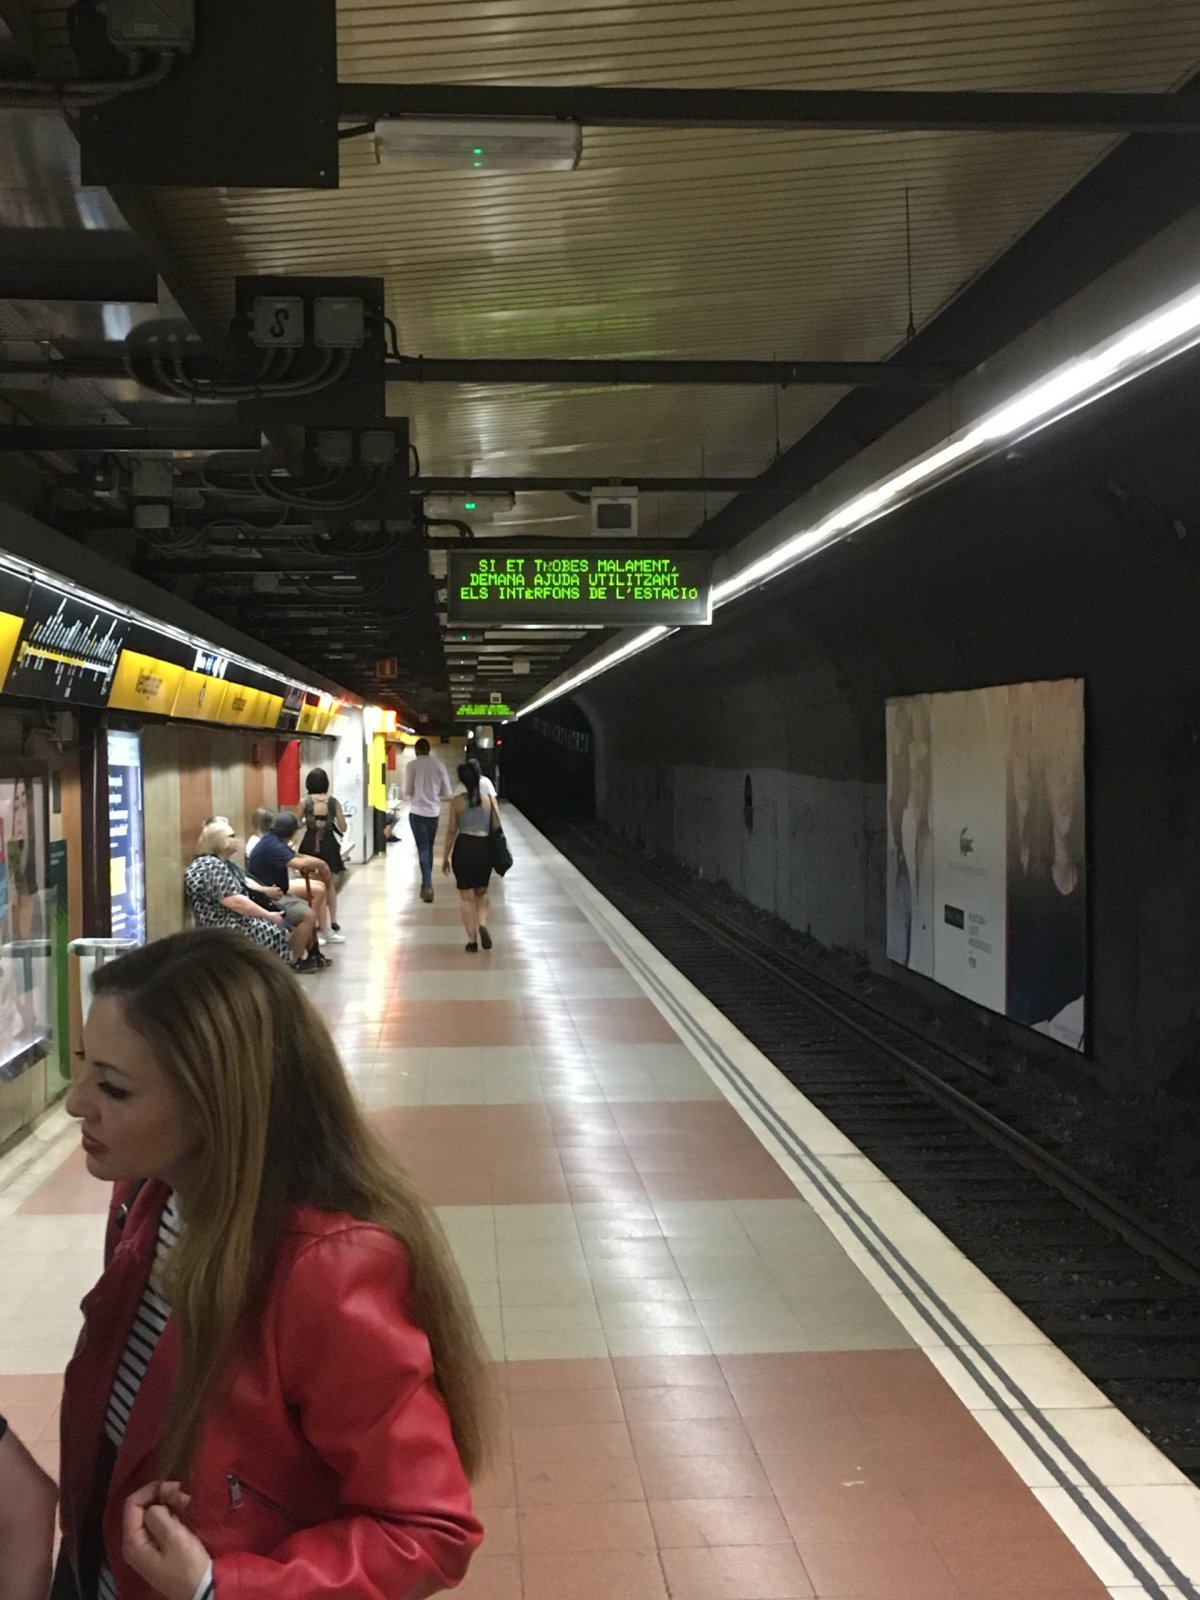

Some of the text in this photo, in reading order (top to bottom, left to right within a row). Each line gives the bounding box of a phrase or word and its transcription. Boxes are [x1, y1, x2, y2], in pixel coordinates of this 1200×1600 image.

[478, 558, 677, 573] SI ET TROBES MALAMENT,
[469, 573, 680, 587] DEMANA AJUDA UTILITZANT
[460, 587, 489, 600] ELS
[588, 587, 607, 600] DE
[615, 587, 698, 600] L'ESTACIÓ
